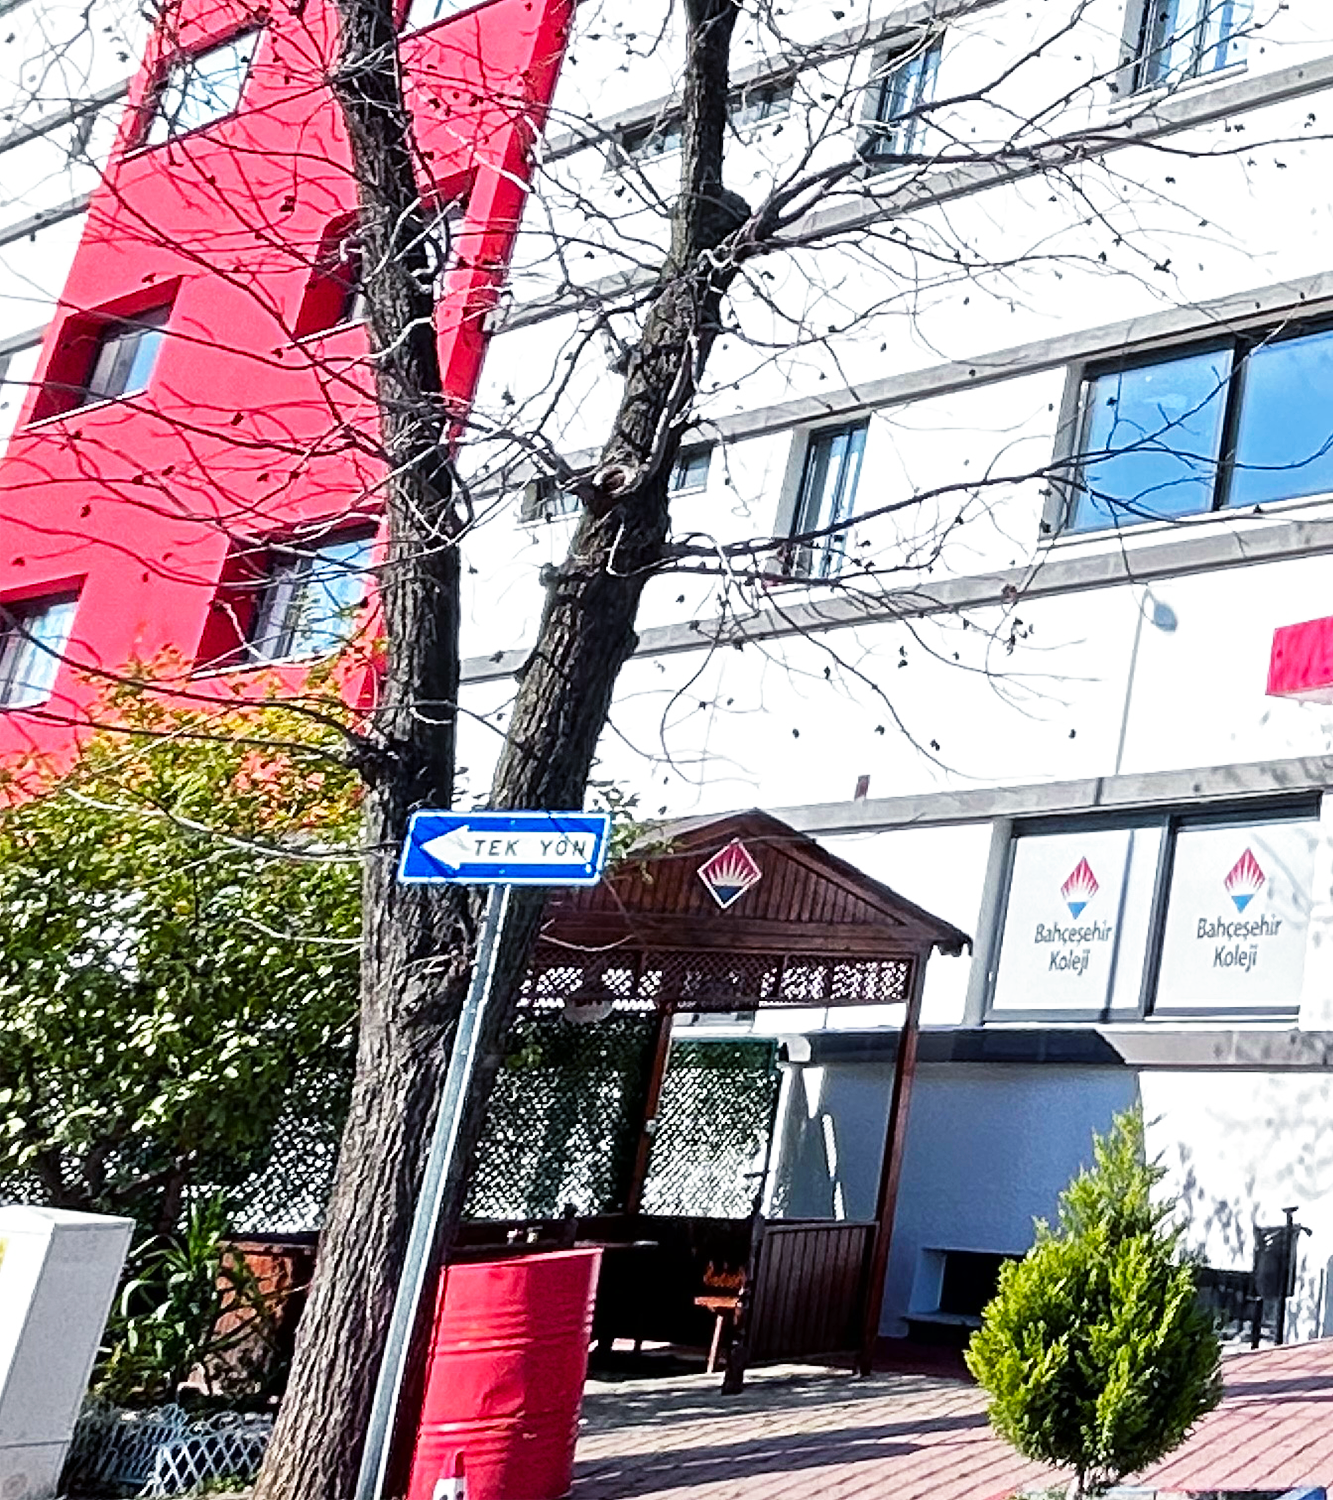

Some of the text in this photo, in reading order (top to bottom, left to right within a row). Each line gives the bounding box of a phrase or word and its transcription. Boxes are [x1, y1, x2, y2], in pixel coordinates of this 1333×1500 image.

[474, 839, 520, 857] TEK
[1034, 920, 1113, 946] Bahçeşehir
[1197, 914, 1283, 942] Bahçeşehir
[1049, 949, 1091, 976] Koleji
[1213, 944, 1259, 973] Koleji
